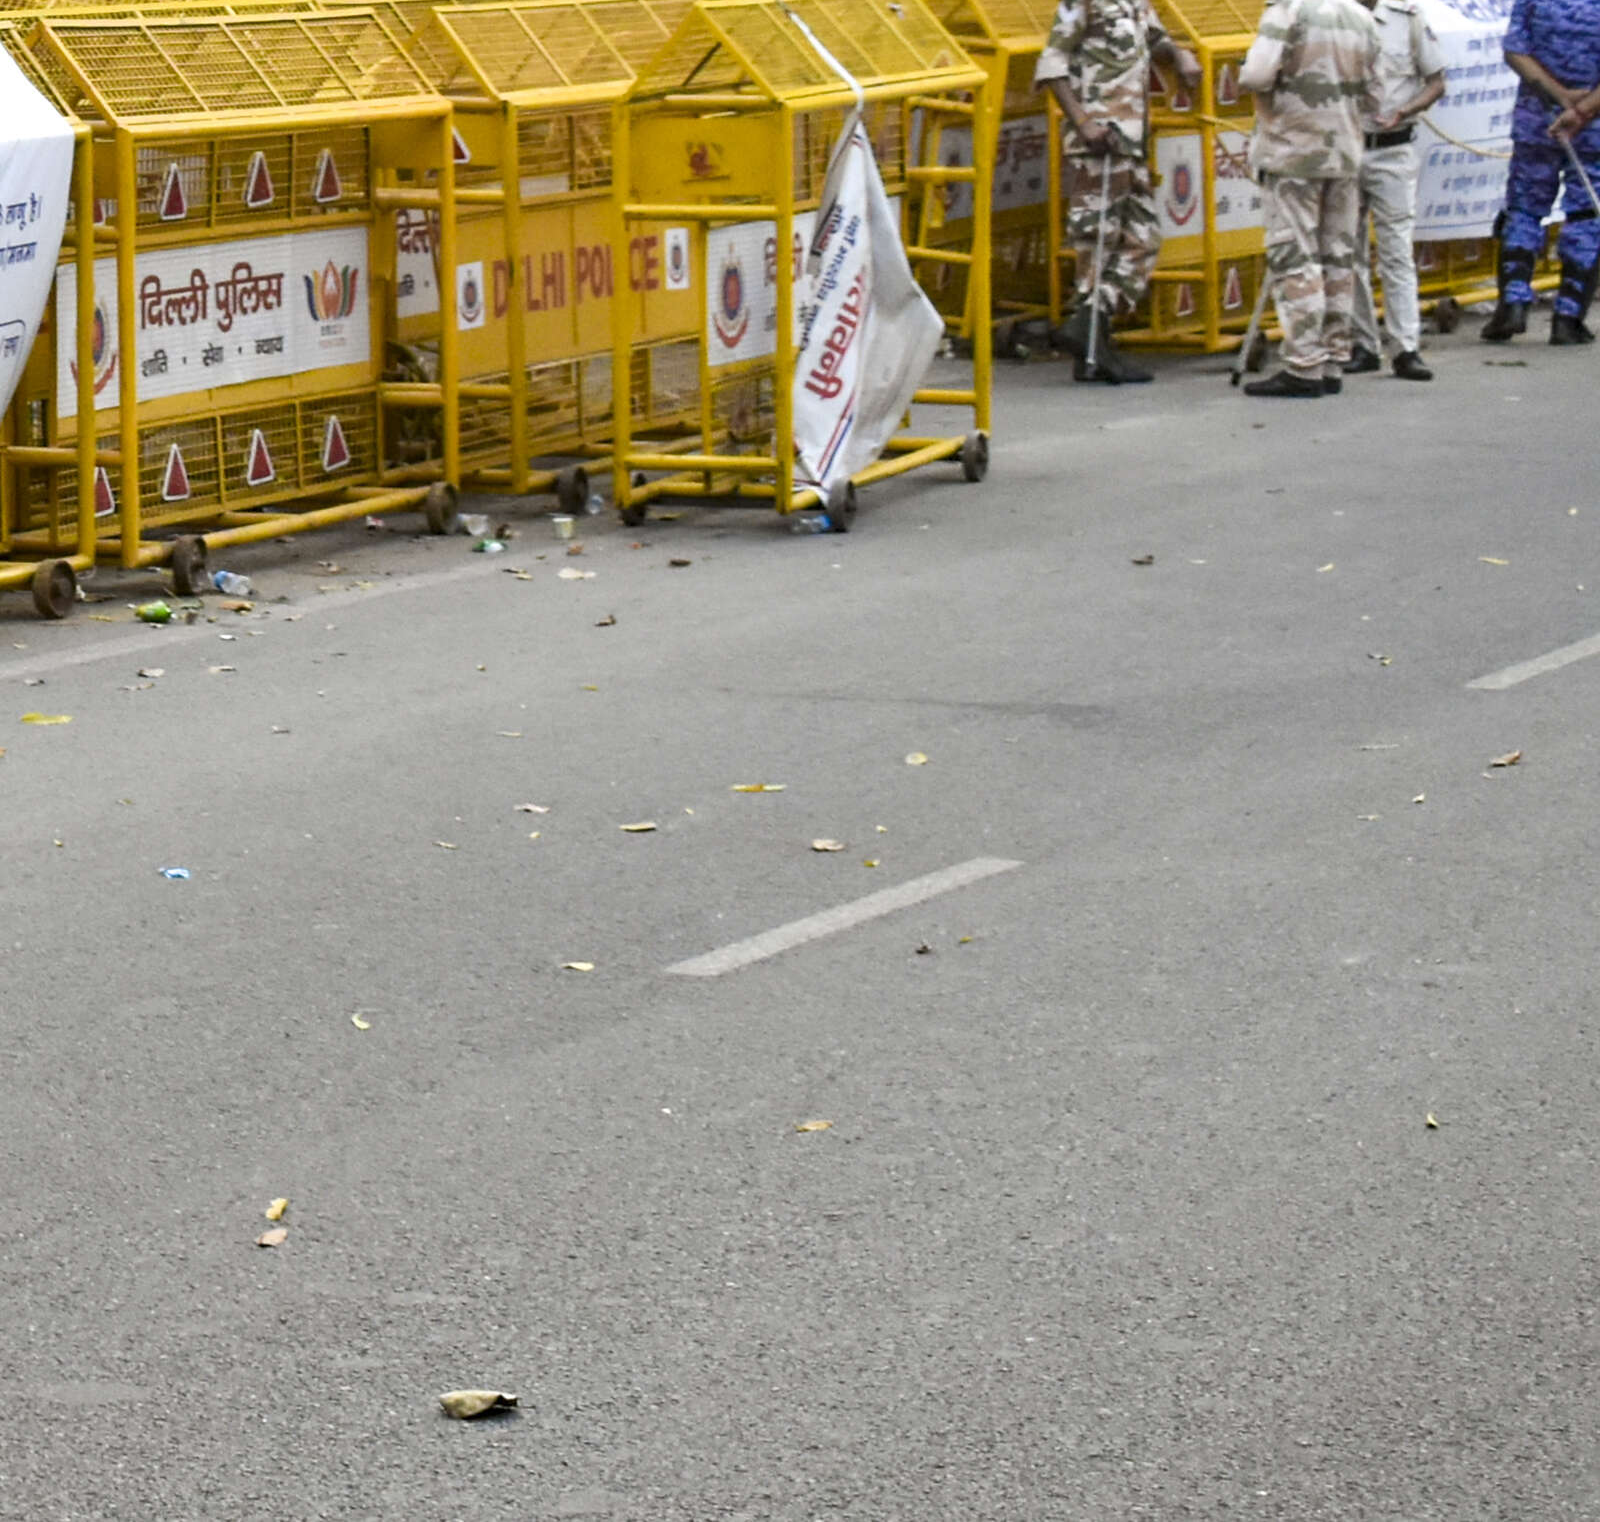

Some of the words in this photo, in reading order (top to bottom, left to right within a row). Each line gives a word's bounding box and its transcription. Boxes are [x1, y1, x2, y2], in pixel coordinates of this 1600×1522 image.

[5, 202, 27, 231] लागू
[139, 268, 210, 330] दिल्ली
[214, 261, 285, 333] पुलिस
[493, 250, 566, 318] DLHI
[575, 235, 659, 304] POLCE
